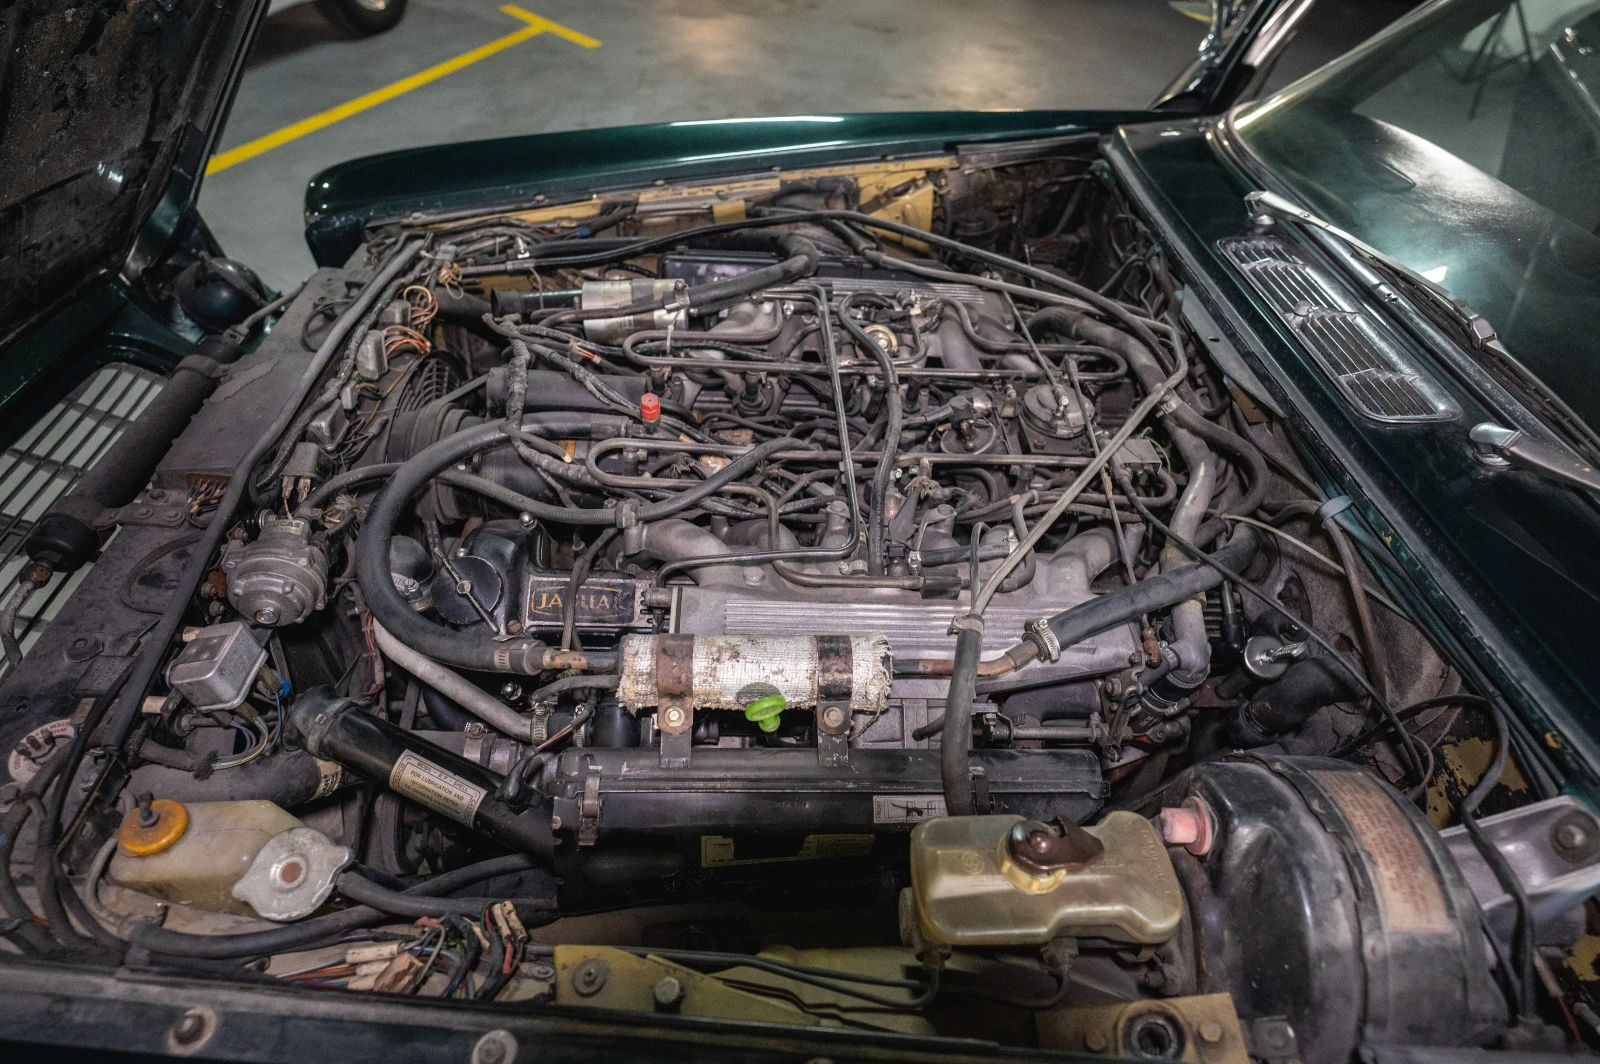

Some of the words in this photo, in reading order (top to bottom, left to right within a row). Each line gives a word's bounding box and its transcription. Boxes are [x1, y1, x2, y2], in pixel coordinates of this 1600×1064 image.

[410, 770, 421, 779] FOR
[421, 776, 453, 796] LUBRICATION
[453, 793, 464, 802] AND
[410, 779, 442, 799] INFORMATION
[443, 796, 459, 807] REFER
